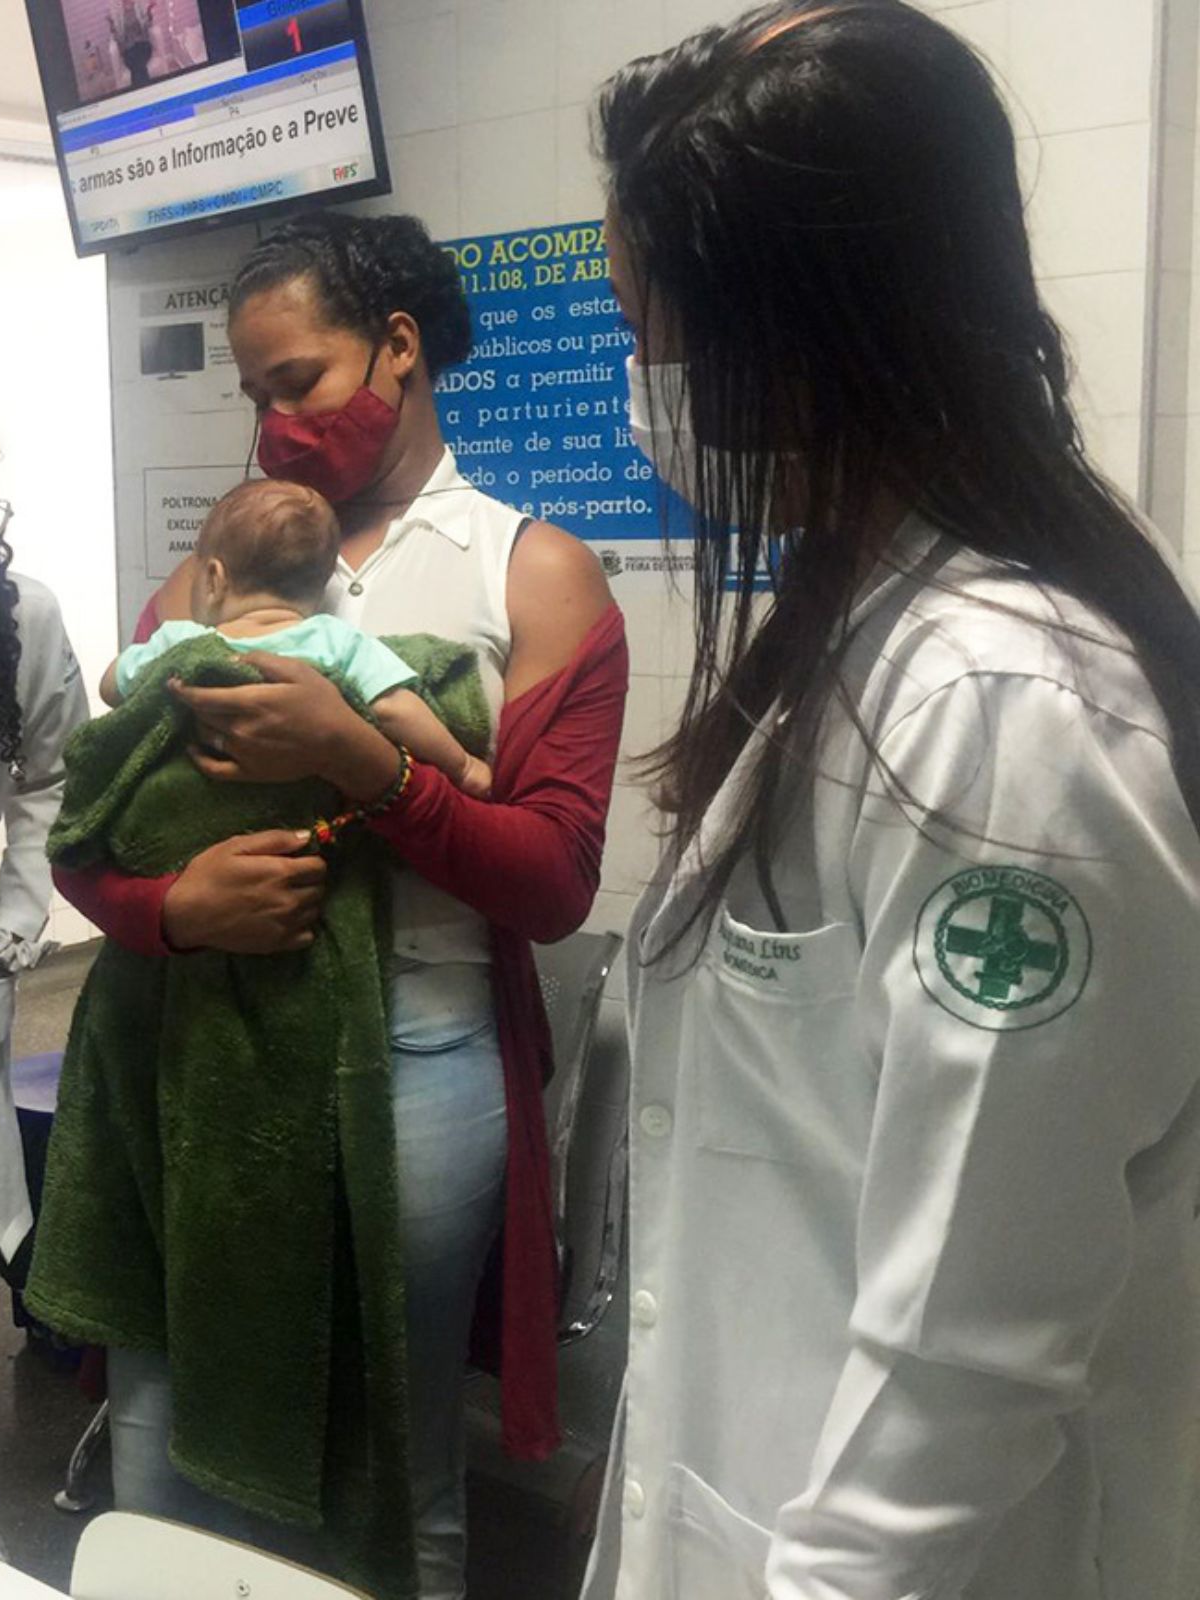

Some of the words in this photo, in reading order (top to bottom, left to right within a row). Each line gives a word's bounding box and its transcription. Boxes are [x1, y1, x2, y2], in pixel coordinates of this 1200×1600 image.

[286, 16, 303, 53] 1
[79, 167, 123, 193] armas
[127, 157, 155, 181] são
[159, 155, 168, 173] a
[172, 127, 266, 169] Informação
[272, 125, 283, 143] e
[288, 120, 298, 139] a
[304, 104, 359, 135] Preve
[535, 263, 567, 286] DE
[479, 308, 518, 331] que
[531, 305, 556, 321] os
[466, 335, 552, 364] públicos
[557, 336, 583, 351] ou
[506, 374, 520, 388] a
[531, 363, 614, 392] permitir
[446, 410, 460, 424] a
[478, 396, 633, 428] parturiente
[524, 432, 550, 452] de
[563, 434, 602, 451] sua
[507, 470, 519, 484] o
[531, 461, 612, 488] período
[624, 460, 653, 480] de
[522, 502, 534, 515] e
[541, 496, 653, 519] pós-parto.
[951, 872, 1069, 914] BIOMEDICINA
[759, 938, 801, 961] Lins
